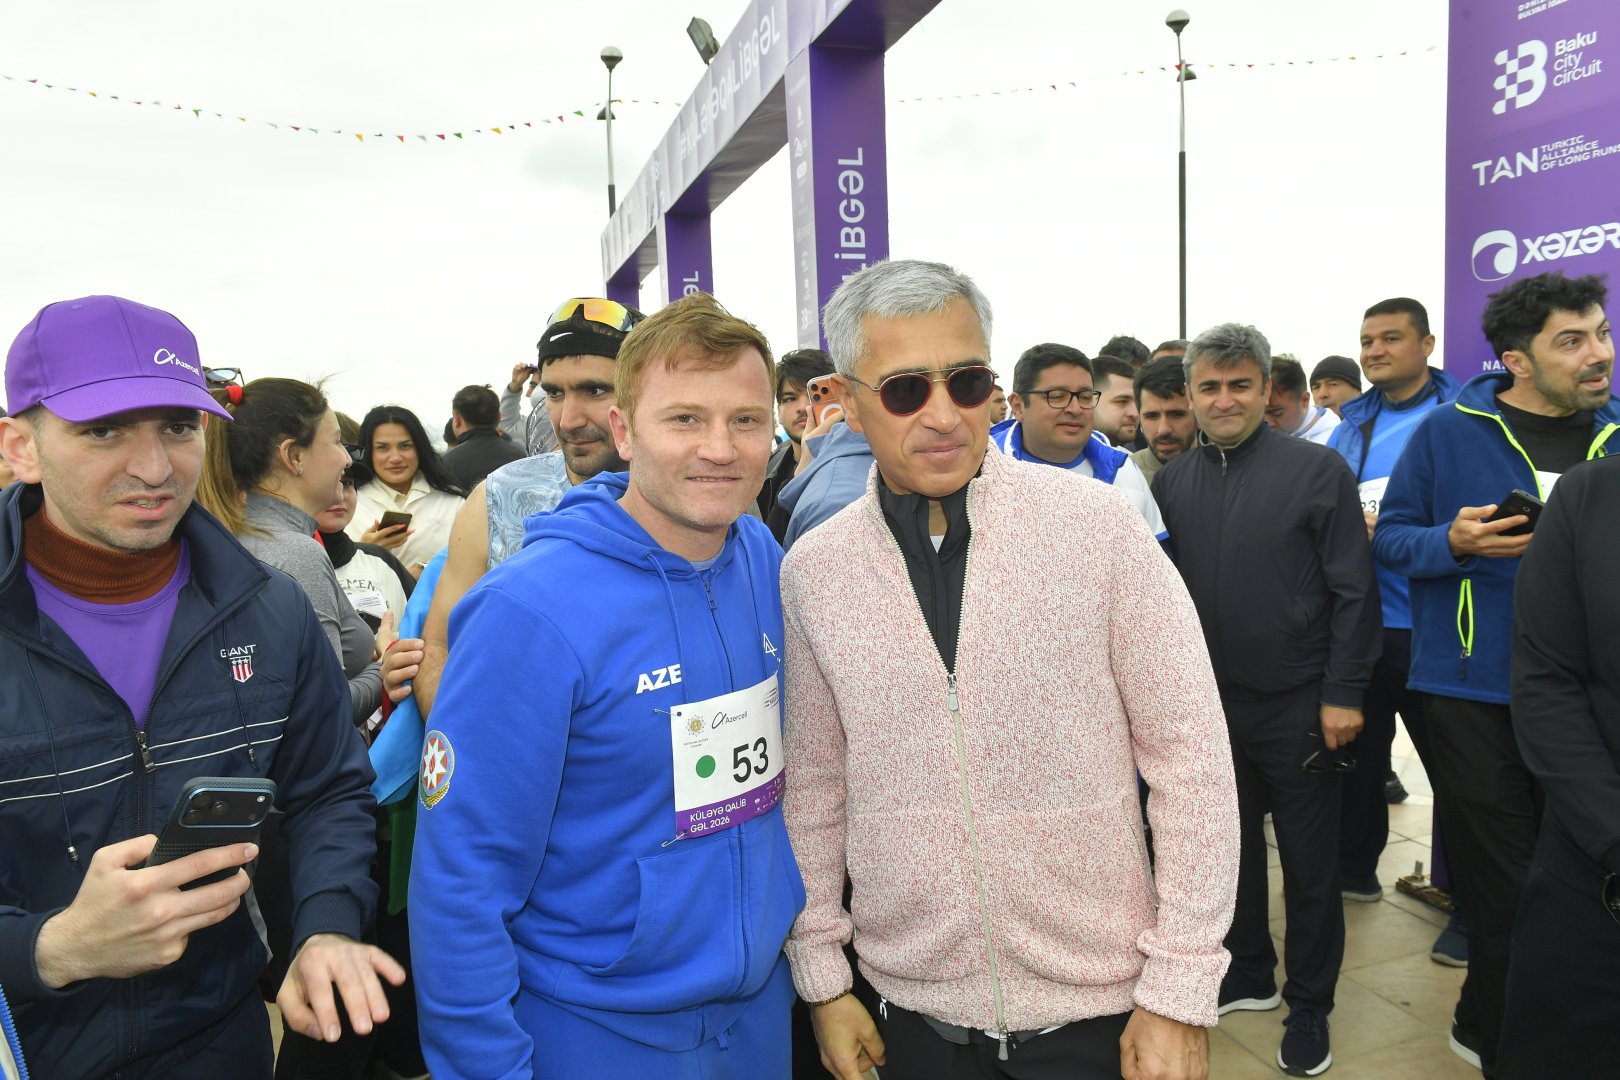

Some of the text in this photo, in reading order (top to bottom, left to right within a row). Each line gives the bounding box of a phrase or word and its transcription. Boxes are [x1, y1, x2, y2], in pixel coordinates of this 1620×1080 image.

[1554, 31, 1598, 56] Baku
[1554, 52, 1583, 70] city
[1553, 59, 1602, 86] circuit
[1540, 135, 1584, 153] TURKIC
[1540, 140, 1599, 162] ALLIANCE
[1472, 147, 1538, 186] TAN
[1540, 160, 1557, 171] OF
[1558, 153, 1591, 167] LONG
[1482, 360, 1506, 371] NA
[220, 644, 257, 658] GANT
[636, 663, 682, 695] AZE
[725, 711, 748, 724] Azercell
[733, 736, 769, 783] 53
[690, 798, 747, 822] KÜLƏYƏ QALİB
[690, 816, 730, 833] GƏL 2026
